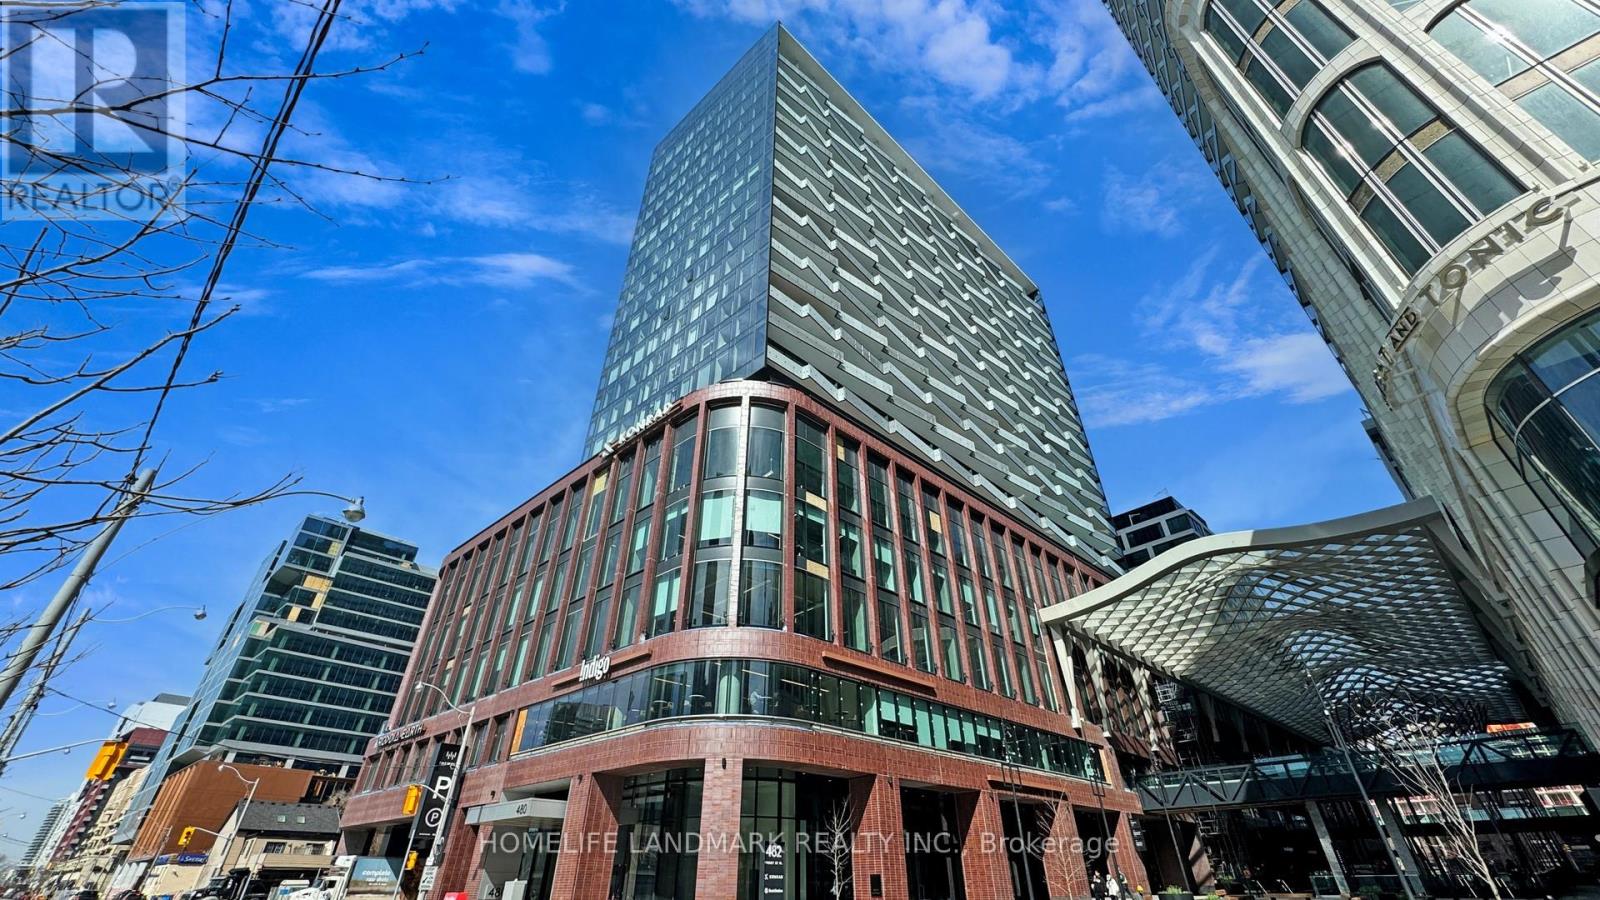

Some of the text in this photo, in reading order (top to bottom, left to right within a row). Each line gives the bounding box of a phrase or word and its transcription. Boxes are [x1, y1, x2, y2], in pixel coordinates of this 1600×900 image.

[1389, 310, 1418, 350] AND
[617, 402, 673, 445] KONRAD
[578, 653, 611, 682] Indigo
[432, 776, 452, 799] P
[515, 803, 528, 815] 480
[765, 844, 782, 858] 482
